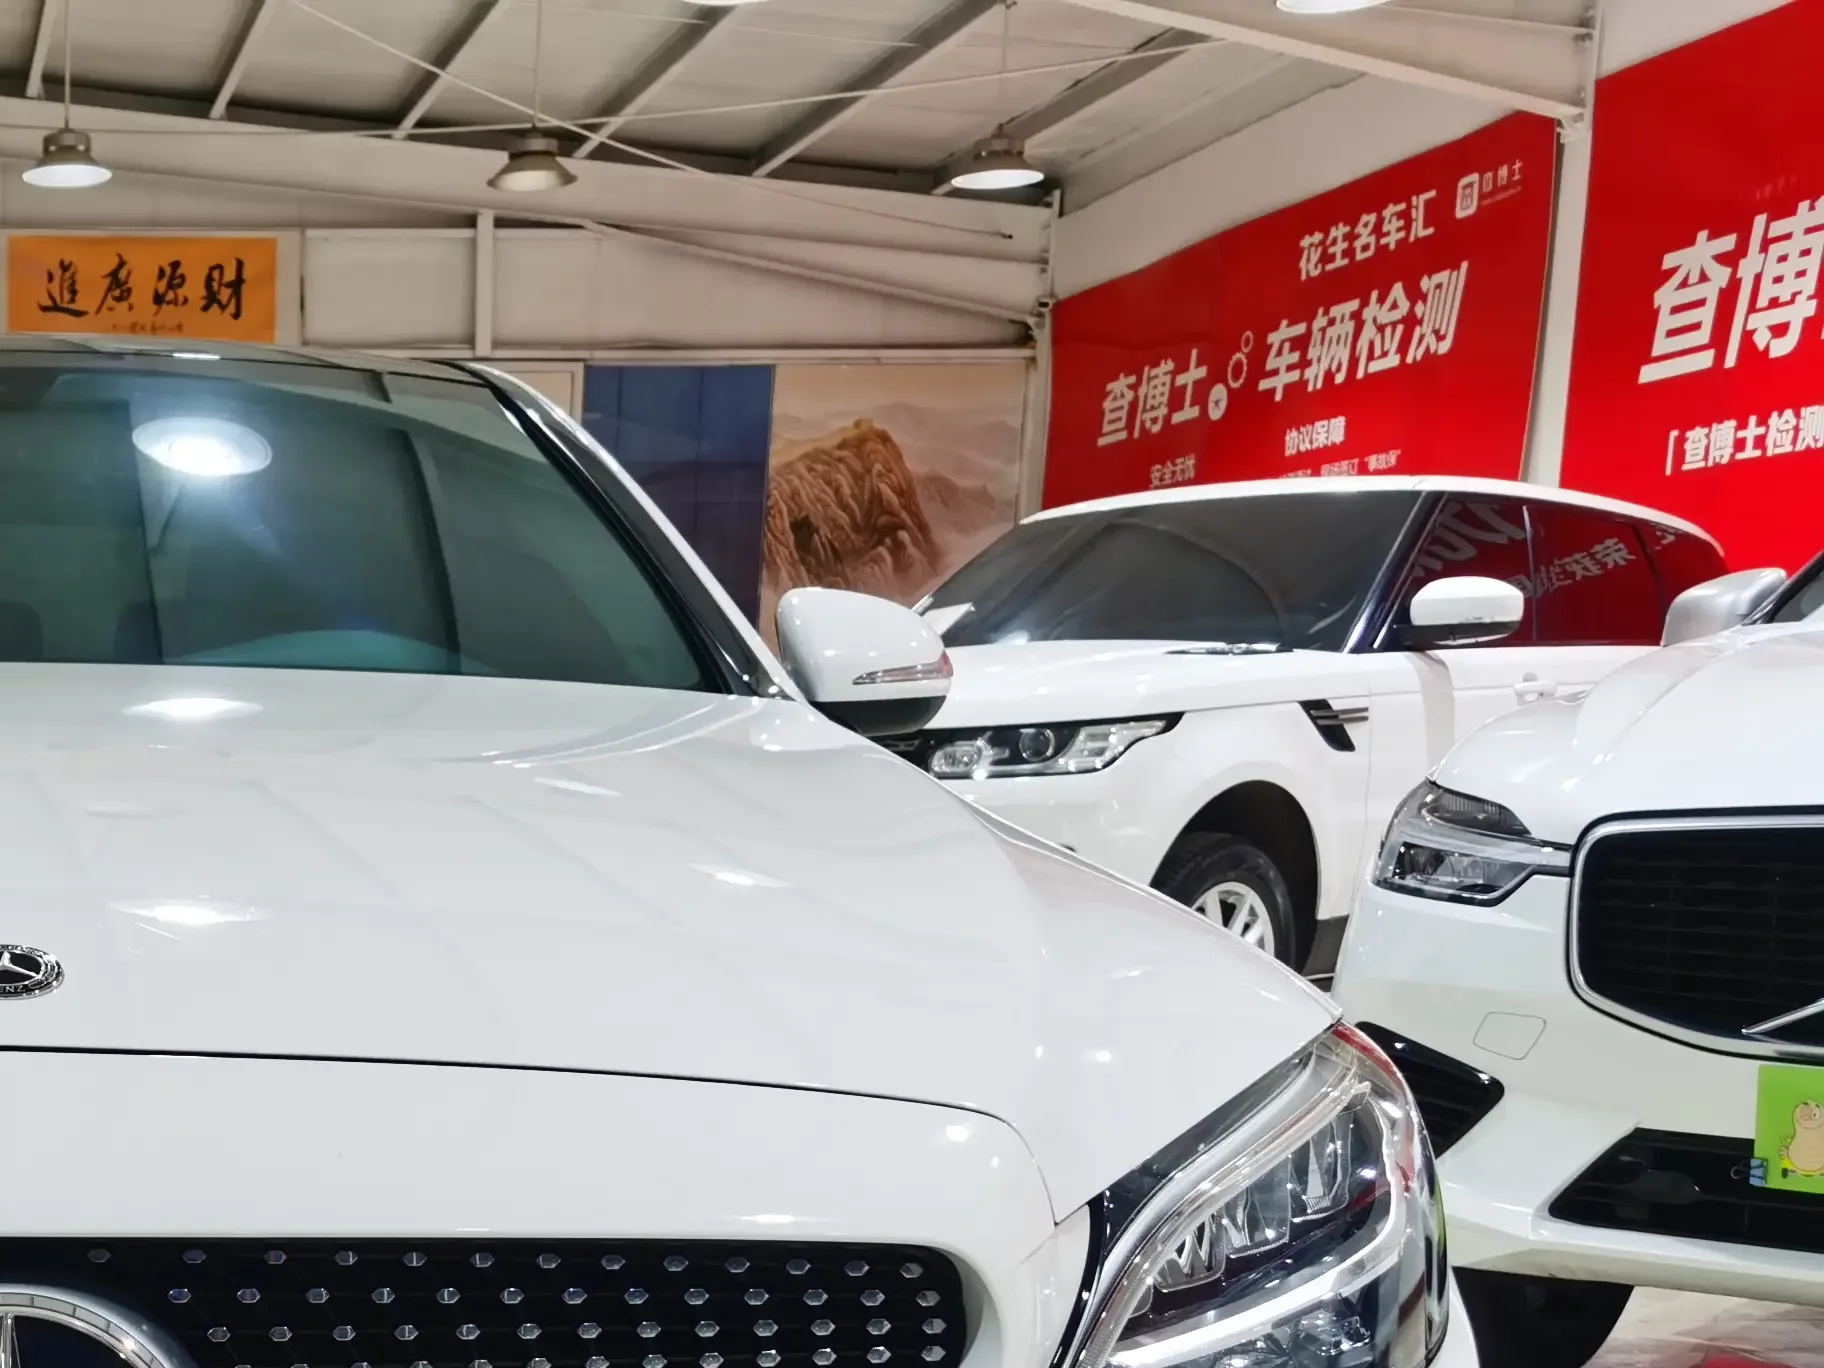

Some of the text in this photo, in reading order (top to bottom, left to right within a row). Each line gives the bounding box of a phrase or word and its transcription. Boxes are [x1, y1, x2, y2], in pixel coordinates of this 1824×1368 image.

[1298, 189, 1438, 282] 花生名车汇
[1257, 260, 1470, 403] 车辆检测
[1637, 194, 1824, 385] 查博
[1096, 347, 1208, 448] 查博士
[1284, 415, 1347, 458] 协议保障
